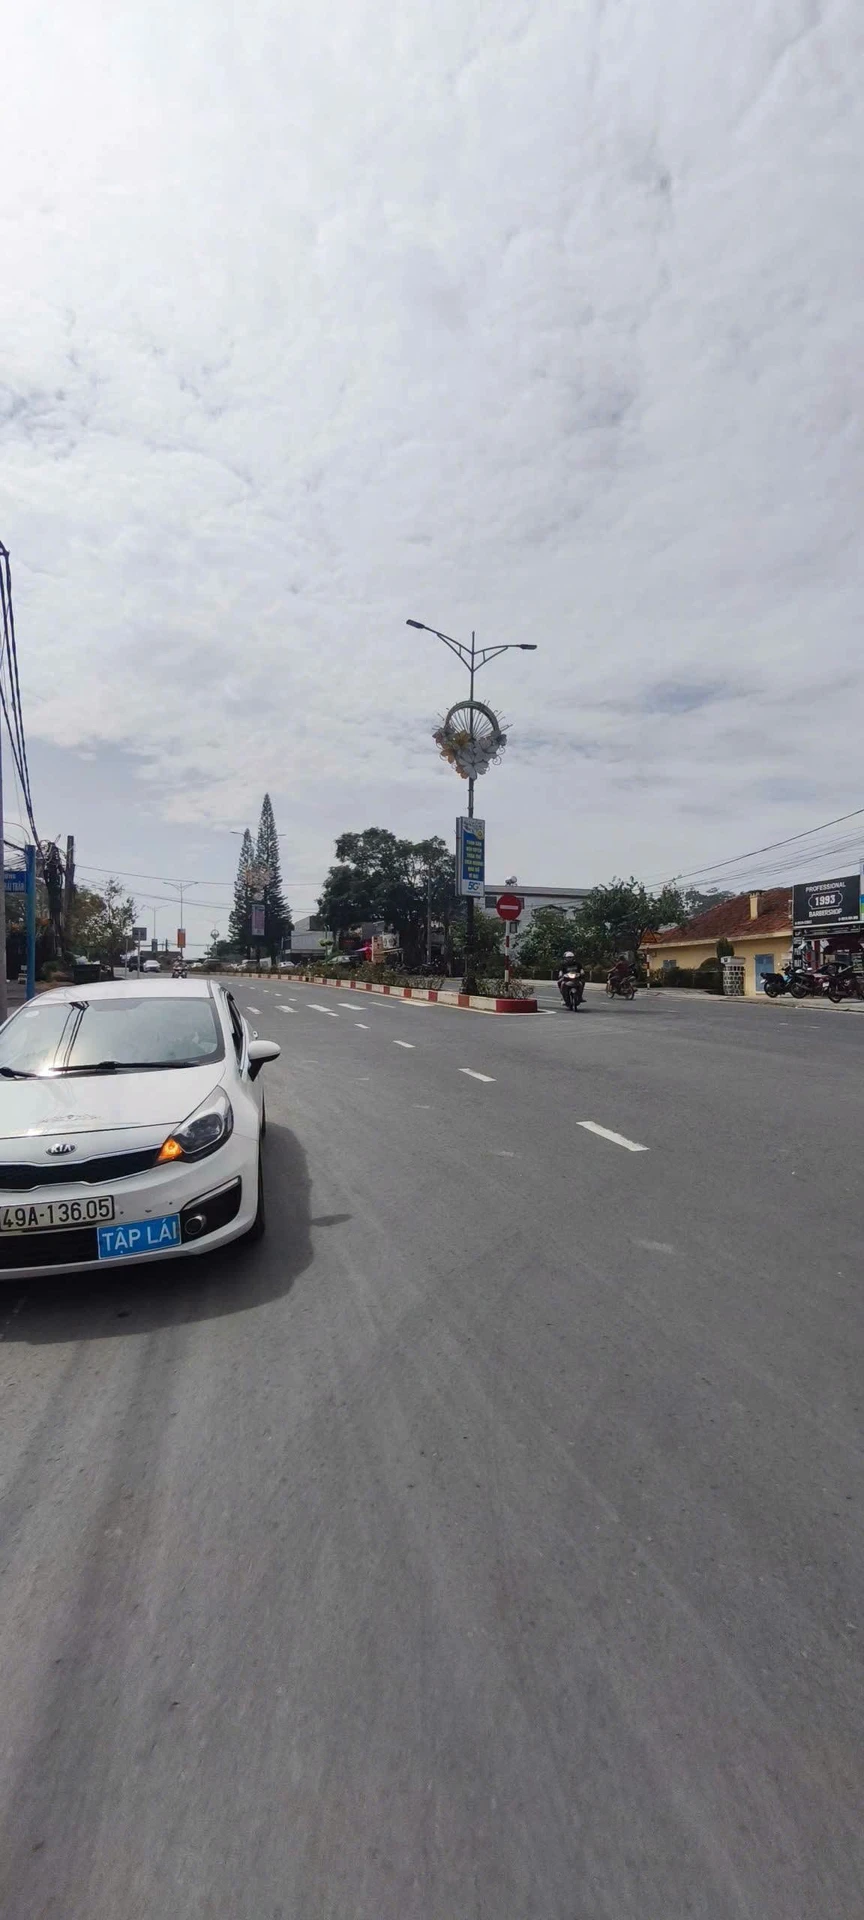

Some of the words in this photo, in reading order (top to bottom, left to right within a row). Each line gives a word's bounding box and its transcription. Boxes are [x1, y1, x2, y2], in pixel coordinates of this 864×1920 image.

[805, 882, 846, 893] PROFESSIONAL
[815, 894, 836, 906] 1993
[808, 908, 843, 917] BARBERSHOP
[49, 1143, 74, 1154] KIA
[1, 1198, 111, 1229] 49A-136.05
[101, 1227, 141, 1255] TẬP
[147, 1220, 177, 1245] LÁI
